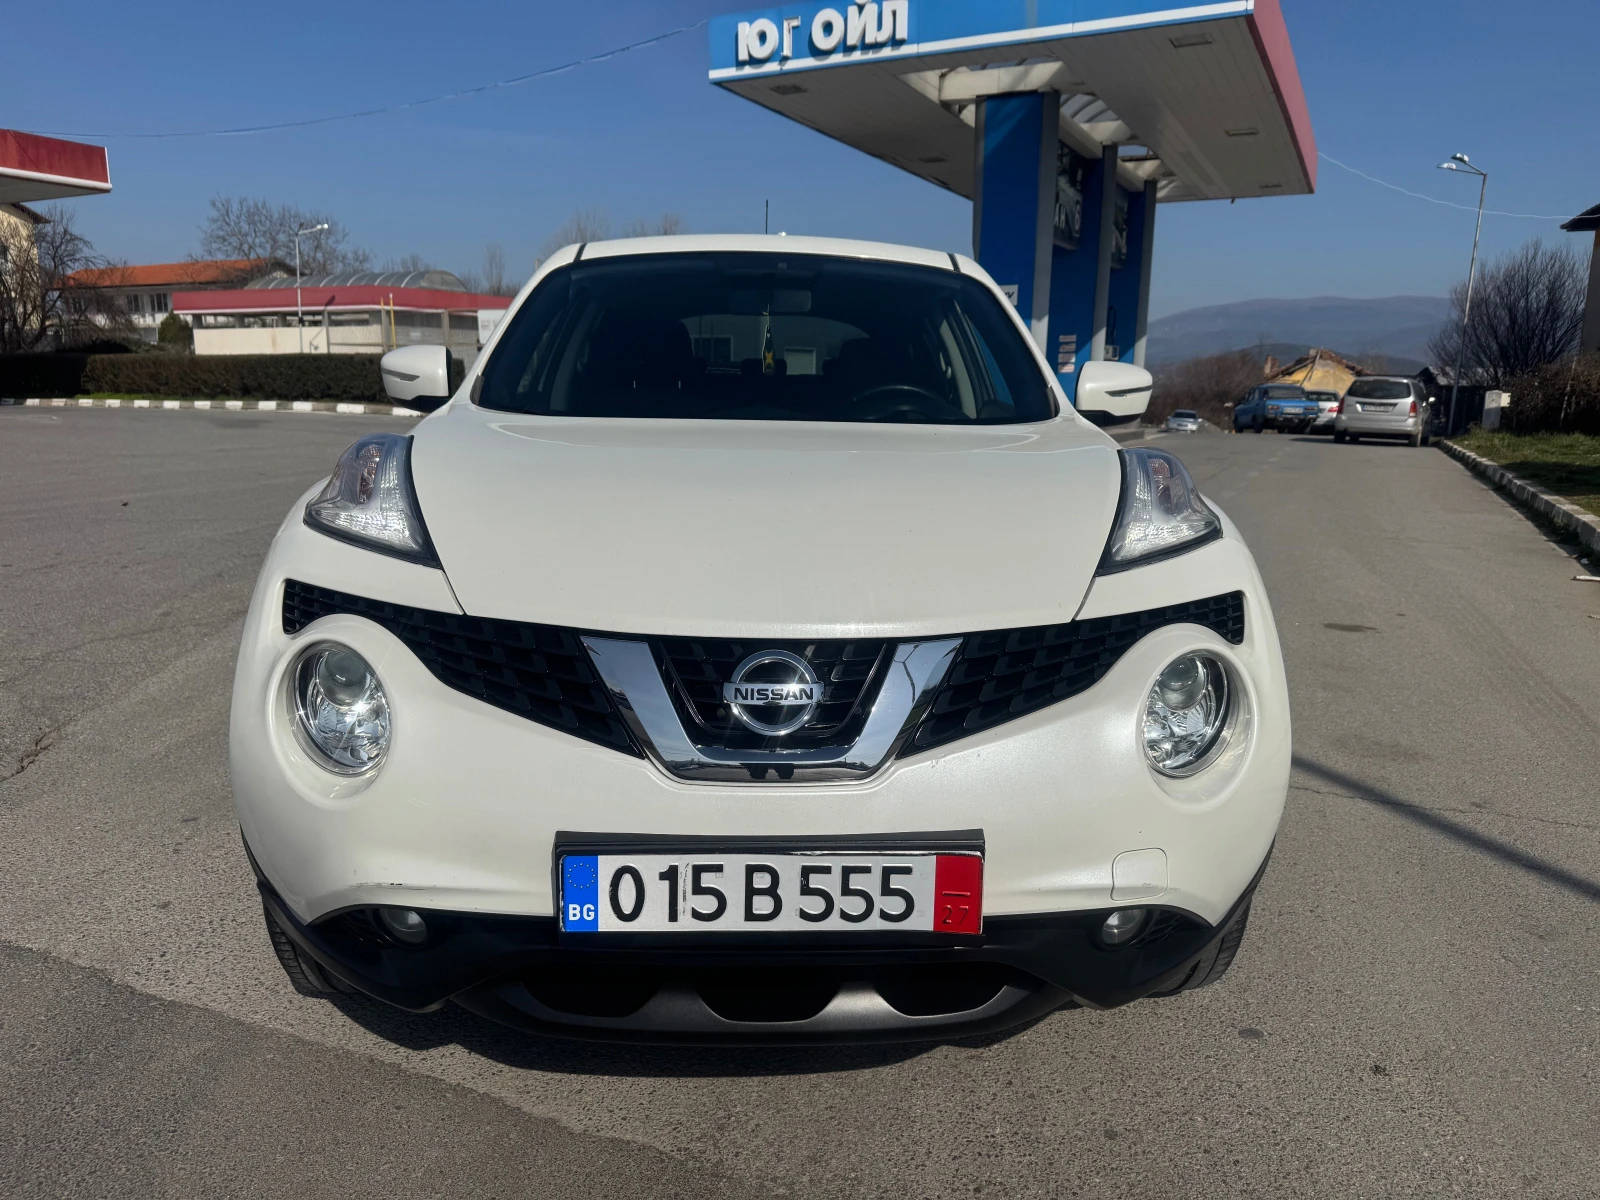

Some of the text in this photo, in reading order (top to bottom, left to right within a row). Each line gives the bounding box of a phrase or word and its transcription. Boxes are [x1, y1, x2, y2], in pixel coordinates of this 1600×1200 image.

[737, 0, 909, 62] ЮГ ОЙЛ
[733, 687, 814, 701] NISSAN
[567, 903, 596, 921] BG
[941, 904, 969, 926] 27
